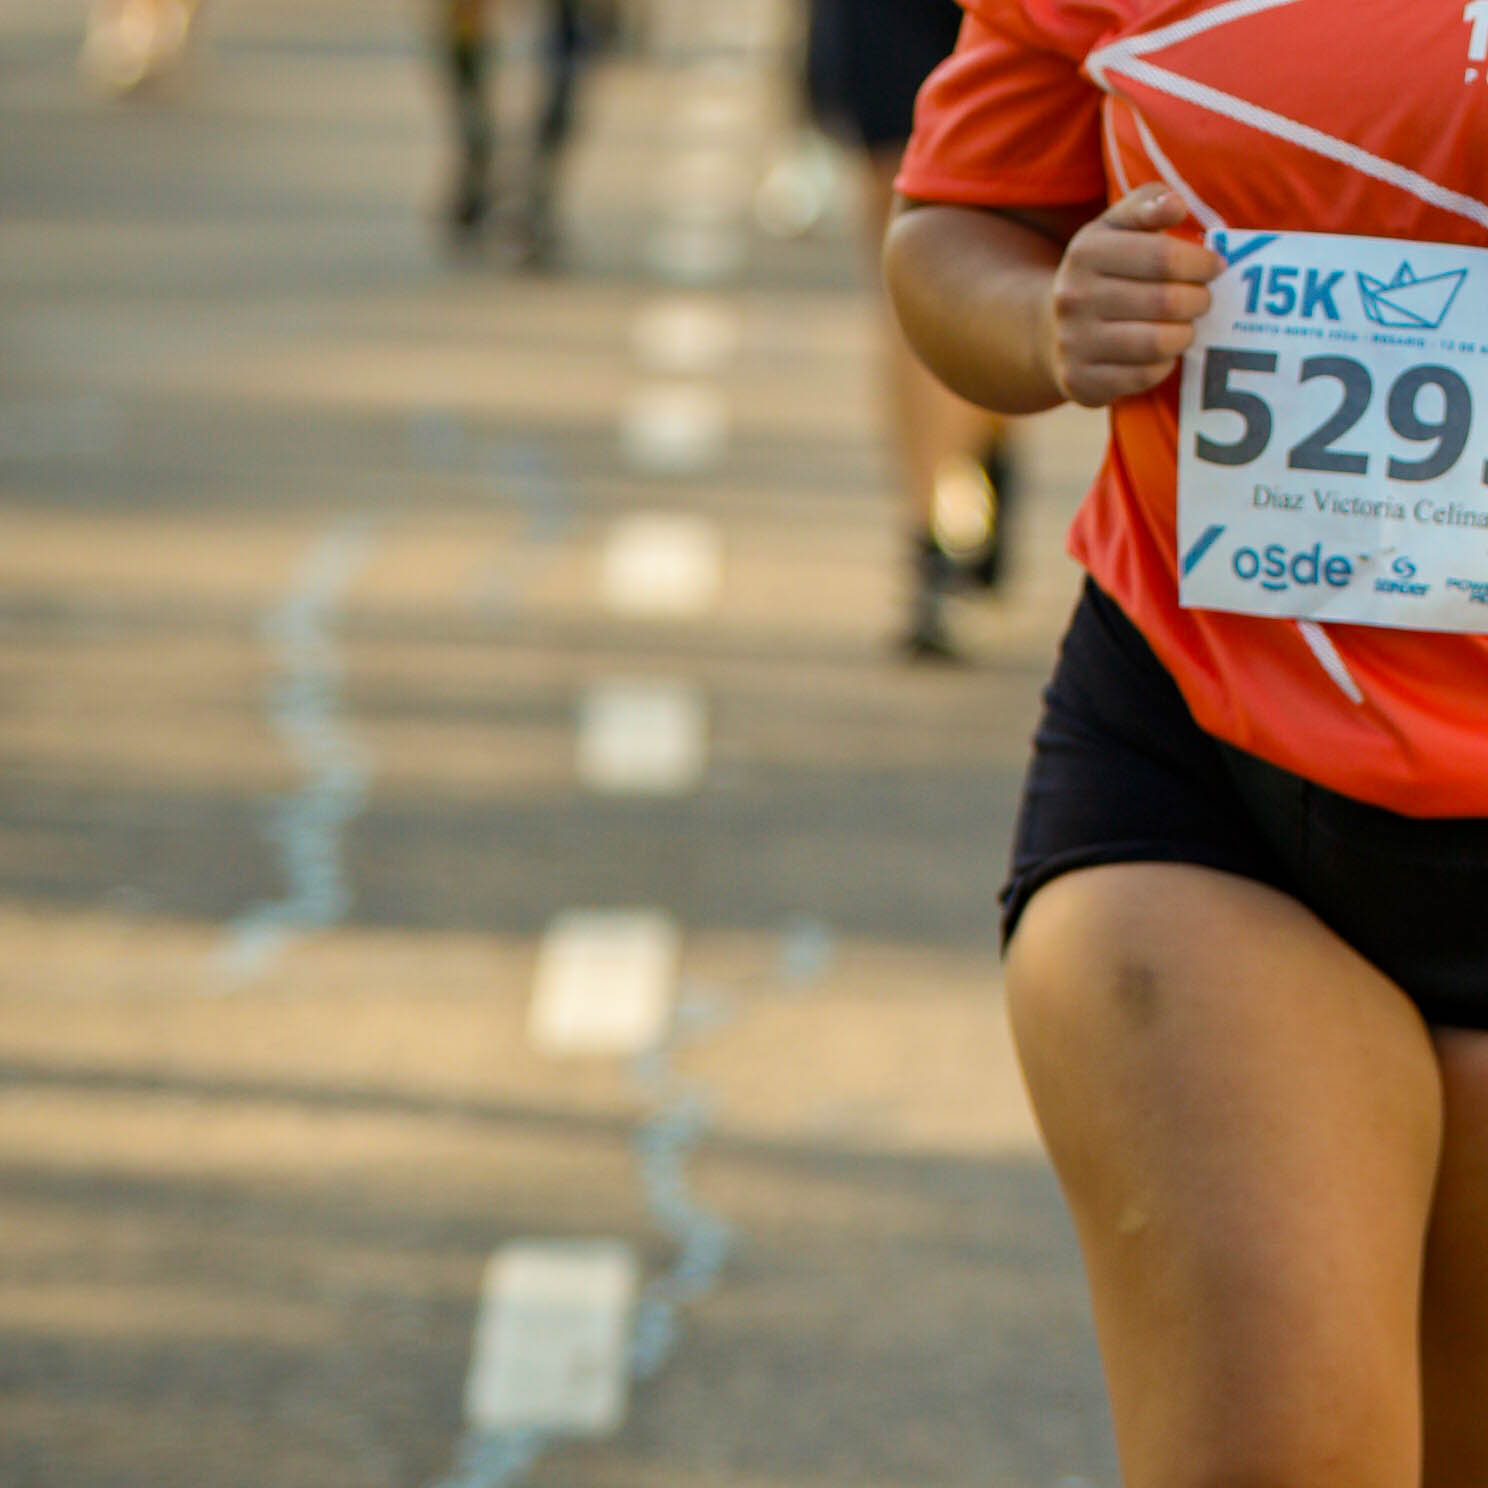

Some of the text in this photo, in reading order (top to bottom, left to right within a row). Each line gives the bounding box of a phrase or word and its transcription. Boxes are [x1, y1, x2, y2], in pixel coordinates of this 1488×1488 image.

[1241, 264, 1345, 321] 15K
[1313, 488, 1405, 520] Victoria
[1232, 541, 1352, 591] osde
